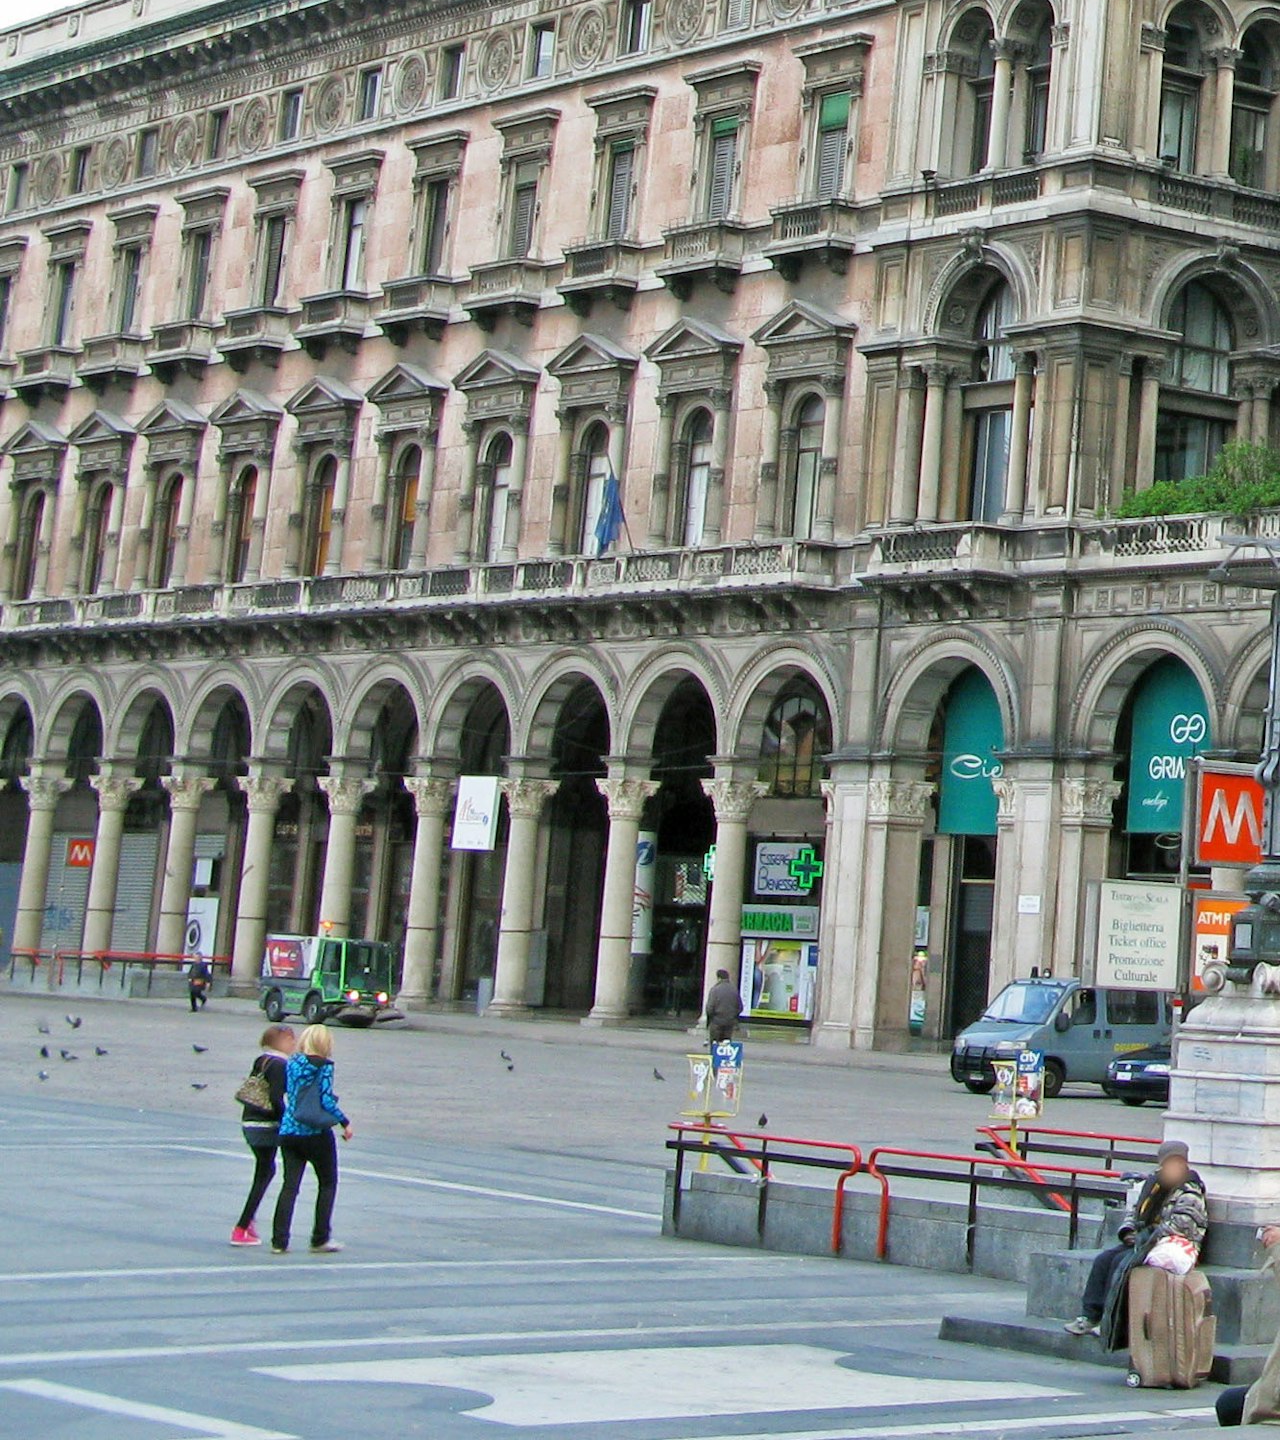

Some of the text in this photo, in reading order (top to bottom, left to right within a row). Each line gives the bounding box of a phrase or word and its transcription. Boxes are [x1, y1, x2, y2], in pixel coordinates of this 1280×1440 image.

[1202, 788, 1263, 846] M
[71, 844, 92, 861] M
[1112, 918, 1165, 933] Biglietteria
[1108, 934, 1167, 948] Ticket office
[1108, 953, 1165, 966] Promozione
[1114, 968, 1158, 982] Culturale
